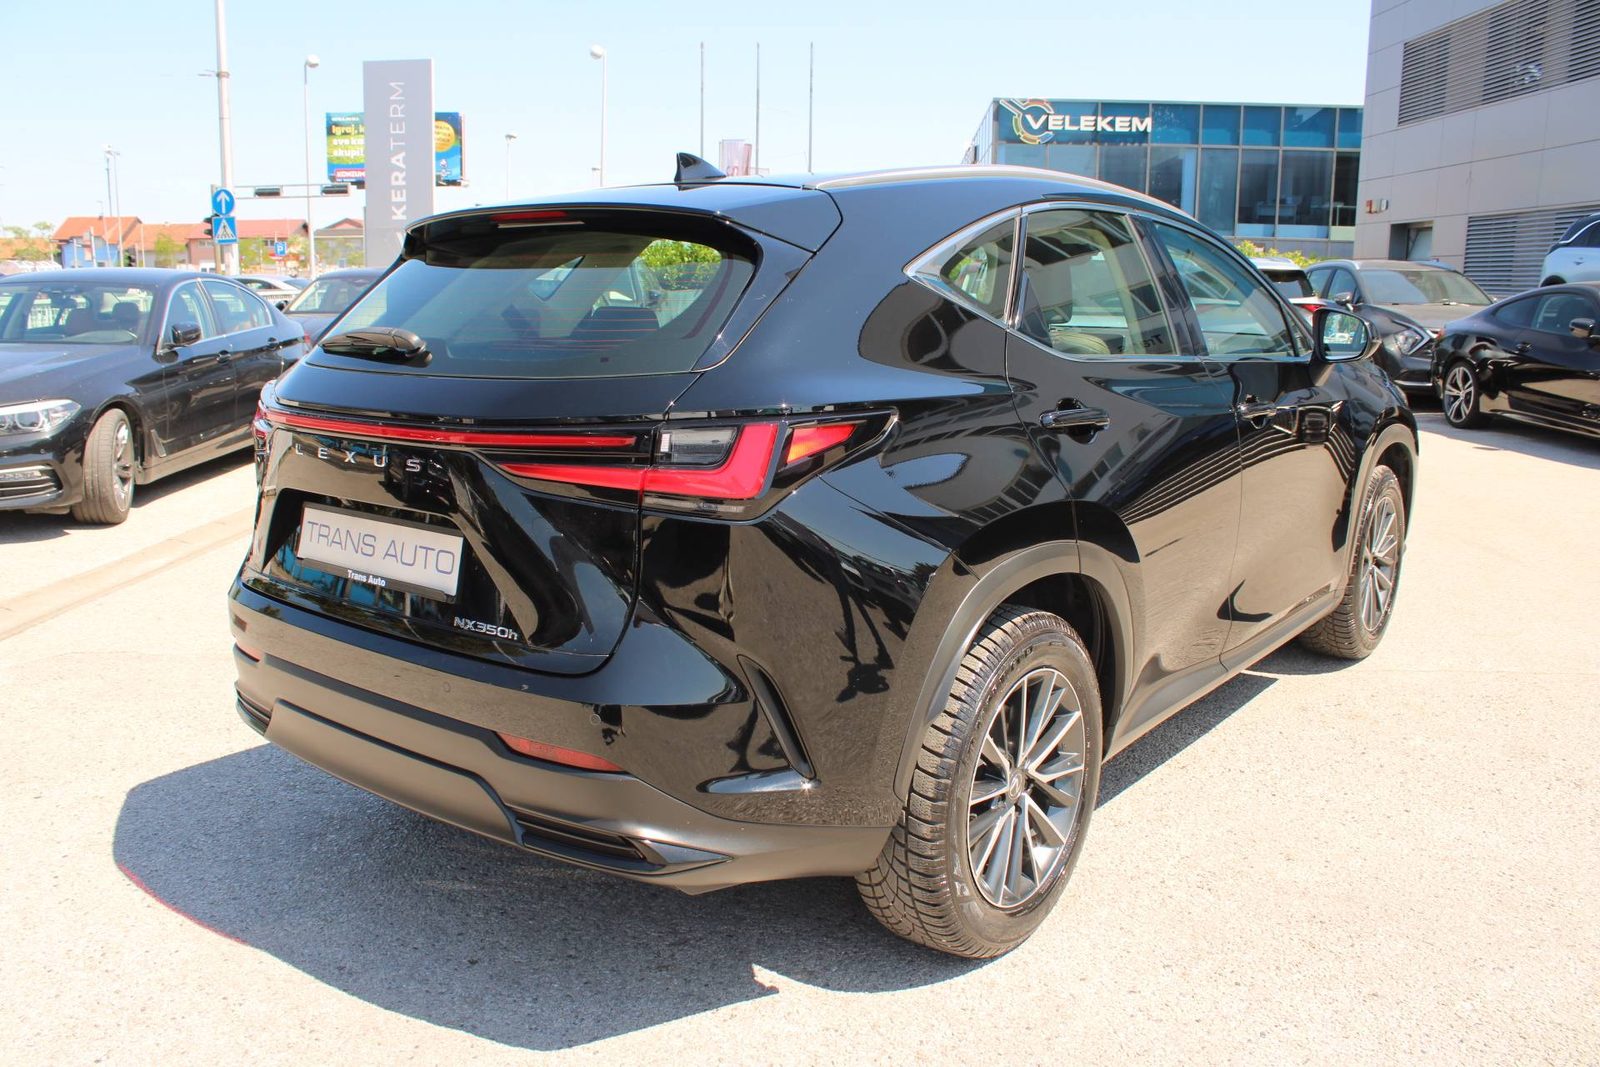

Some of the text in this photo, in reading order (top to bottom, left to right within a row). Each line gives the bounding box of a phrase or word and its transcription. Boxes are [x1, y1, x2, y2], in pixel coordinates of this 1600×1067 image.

[1025, 114, 1152, 133] VELEKEM
[389, 81, 407, 220] KERATERM
[295, 443, 421, 472] LEXUS
[307, 520, 455, 575] TRANS AUTO
[347, 569, 386, 587] Trans Auto
[453, 616, 518, 640] NX350h
